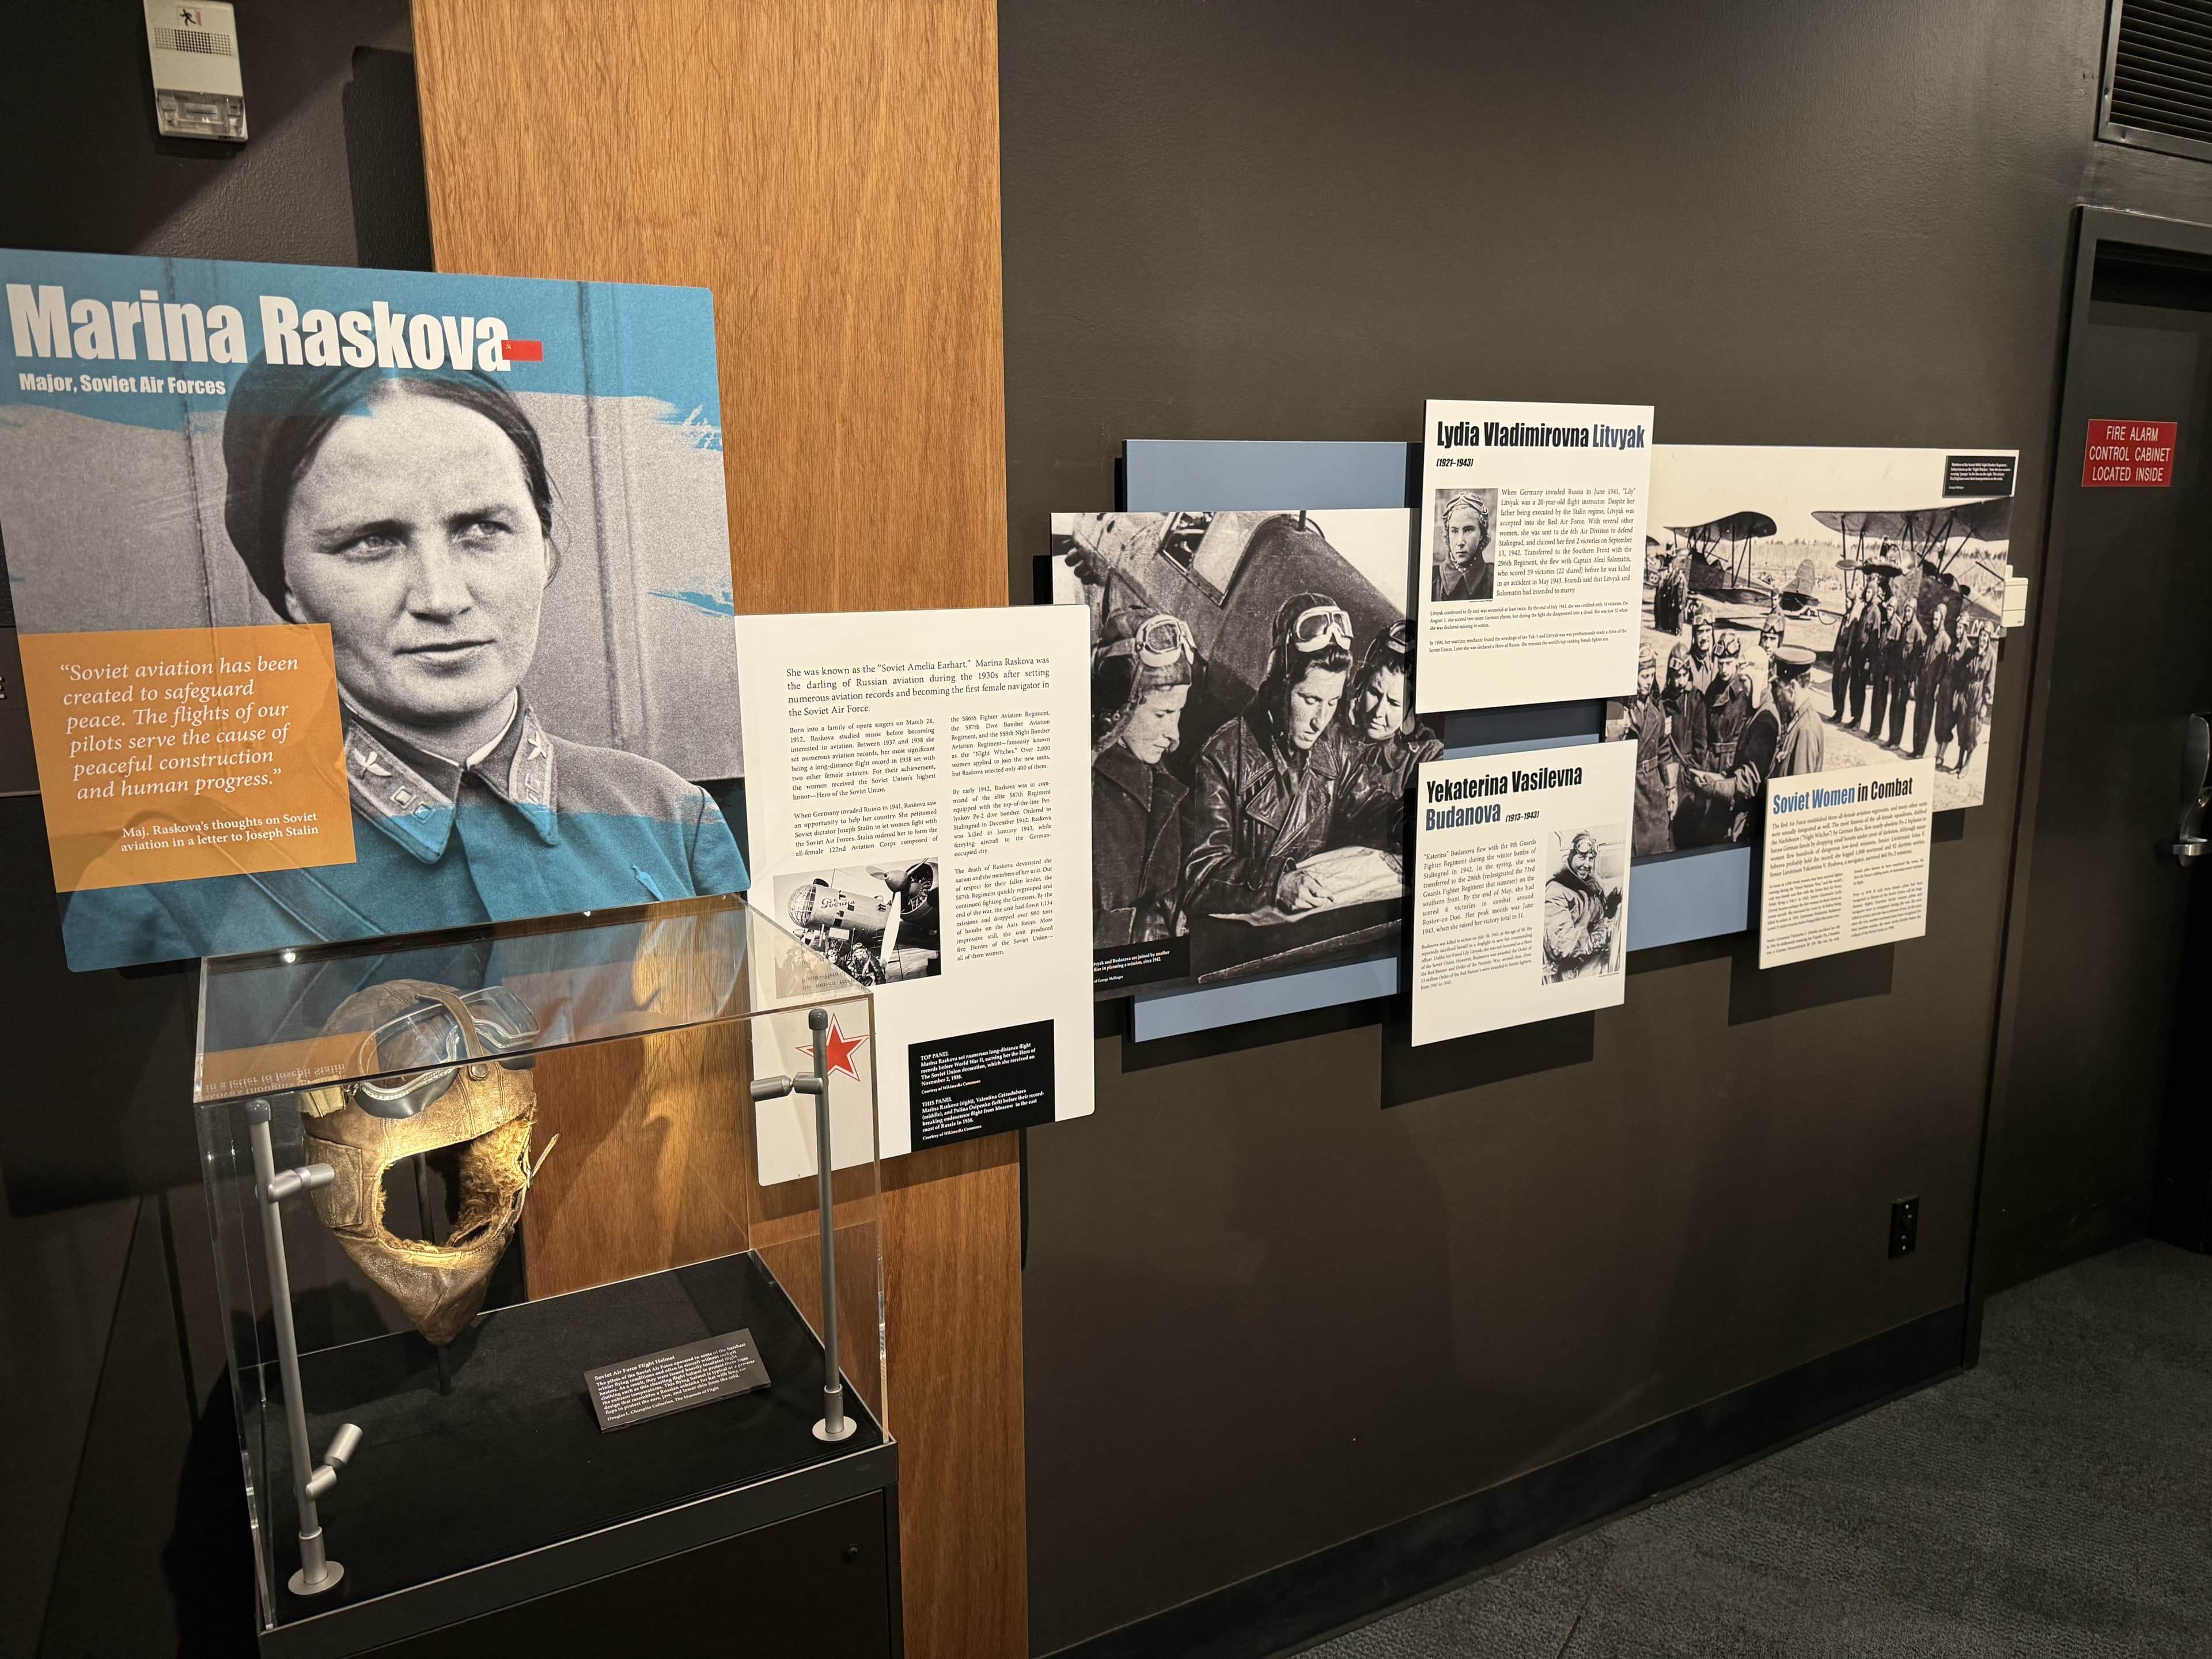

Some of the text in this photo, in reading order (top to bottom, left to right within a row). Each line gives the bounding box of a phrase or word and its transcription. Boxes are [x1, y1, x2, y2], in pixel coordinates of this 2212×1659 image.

[6, 284, 511, 372] Marina Raskova
[19, 373, 226, 395] Major, Soviet Air Forces
[1437, 421, 1645, 450] Lydia Vladimirovna Litvyak
[2106, 426, 2158, 441] FIRE ALARM
[2089, 445, 2171, 462] CONTROL CABINET
[2092, 466, 2164, 482] LOCATED INSIDE
[135, 660, 213, 677] aviation
[219, 657, 251, 673] has
[257, 655, 298, 672] been
[786, 668, 801, 677] She
[821, 666, 849, 675] known
[863, 664, 875, 673] the
[907, 661, 935, 671] Amelia
[975, 659, 1002, 667] Marina
[1005, 657, 1034, 665] Raskova
[63, 678, 254, 705] created to safeguard
[787, 669, 1050, 690] the darling of Russian aviation during the 1930s after setting
[788, 695, 829, 703] numerous
[831, 692, 863, 700] aviation
[865, 689, 894, 699] records
[896, 688, 910, 697] and
[912, 687, 950, 696] becoming
[952, 685, 963, 694] the
[965, 684, 980, 693] first
[982, 683, 1006, 692] female
[1007, 682, 1040, 691] navigator
[65, 701, 289, 734] peace. The flights of our
[789, 704, 870, 717] the Soviet Air Force.
[69, 722, 291, 757] pilots serve the cause of
[73, 749, 274, 781] peaceful construction
[77, 780, 115, 800] and
[121, 779, 189, 796] human
[1426, 767, 1582, 803] Yekaterina Vasilevna
[1773, 777, 1912, 815] Soviet Women in Combat
[122, 826, 149, 838] Maj.
[211, 816, 263, 830] thoughts
[266, 817, 281, 825] on
[283, 812, 317, 823] Soviet
[1426, 804, 1501, 831] Budanova
[121, 839, 169, 851] aviation
[172, 837, 184, 847] in
[197, 834, 228, 844] letter
[231, 833, 243, 842] to
[245, 827, 283, 842] Joseph
[286, 825, 319, 836] Stalin
[932, 1051, 949, 1059] PANEL
